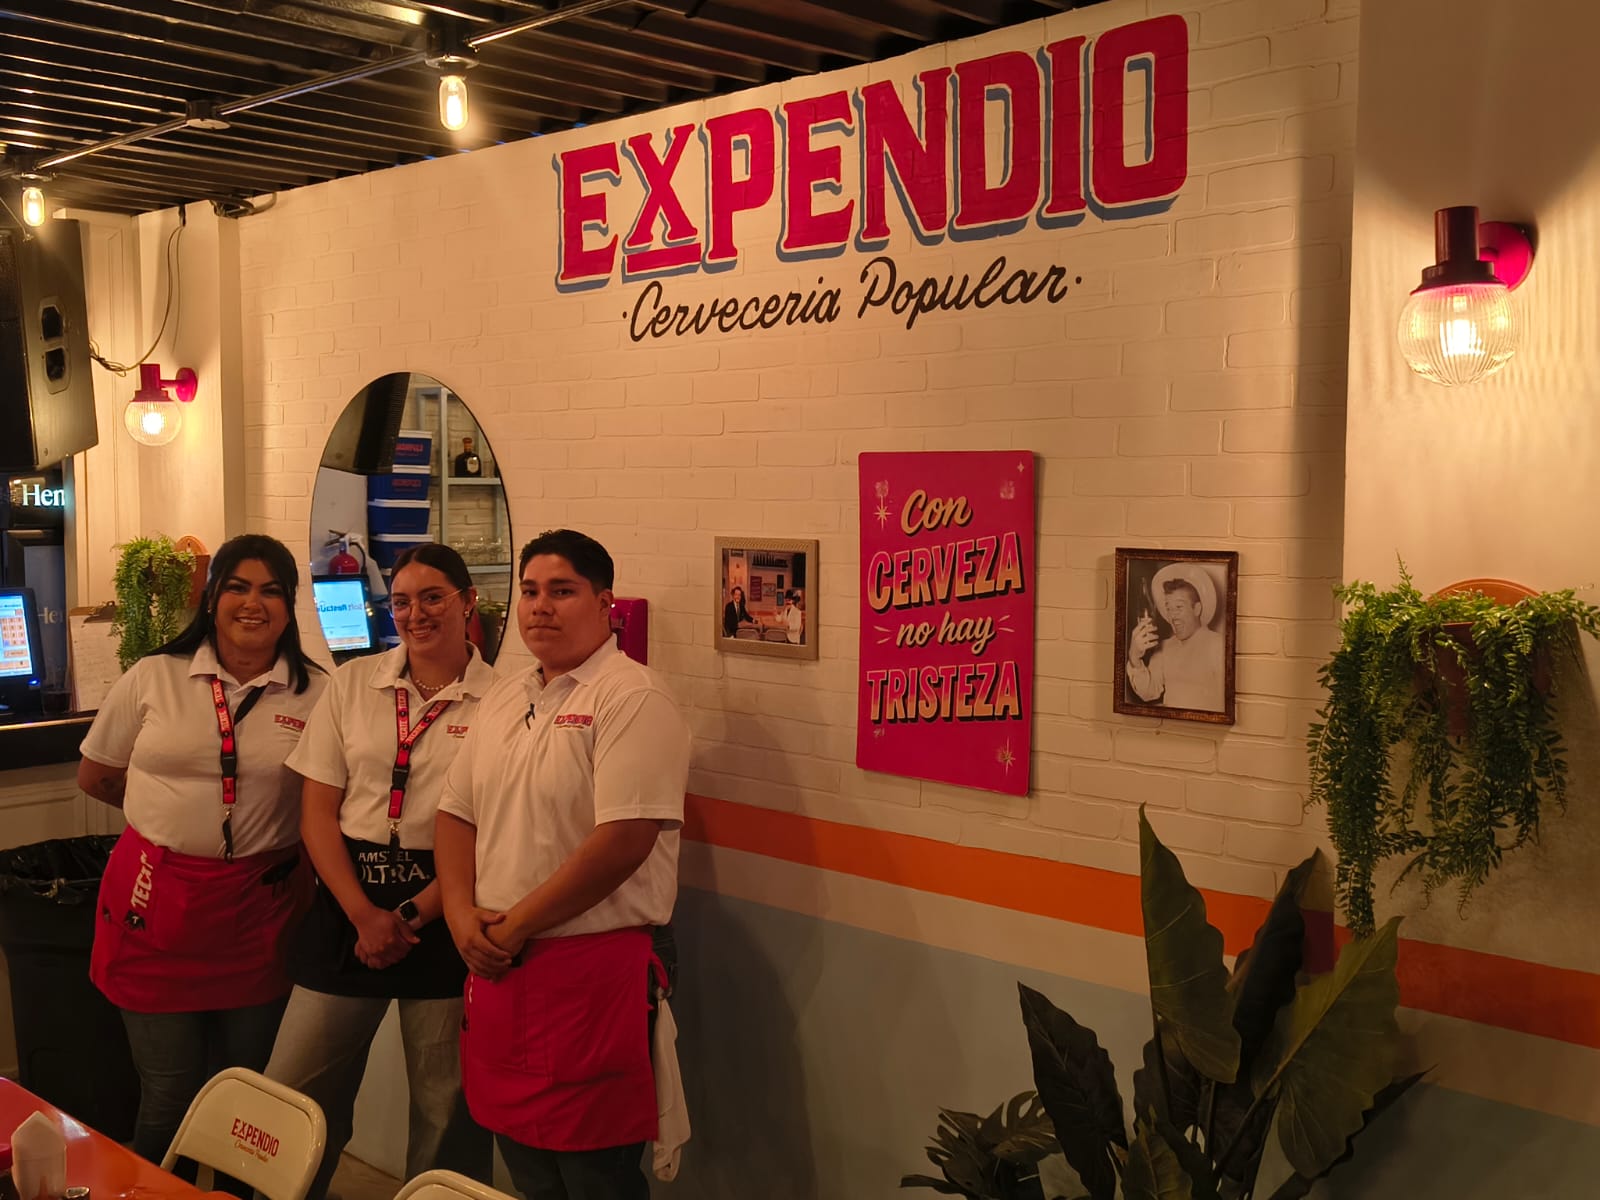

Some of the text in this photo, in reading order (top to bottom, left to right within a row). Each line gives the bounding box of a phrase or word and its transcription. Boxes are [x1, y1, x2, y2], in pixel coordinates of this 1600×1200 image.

[554, 14, 1189, 291] EXPENDIO
[858, 256, 1068, 330] Popular
[901, 489, 972, 535] Con
[867, 531, 1025, 612] CERVEZA
[896, 611, 996, 656] no hay
[867, 661, 1022, 722] TRISTEZA
[231, 1117, 280, 1157] EXPENDIO
